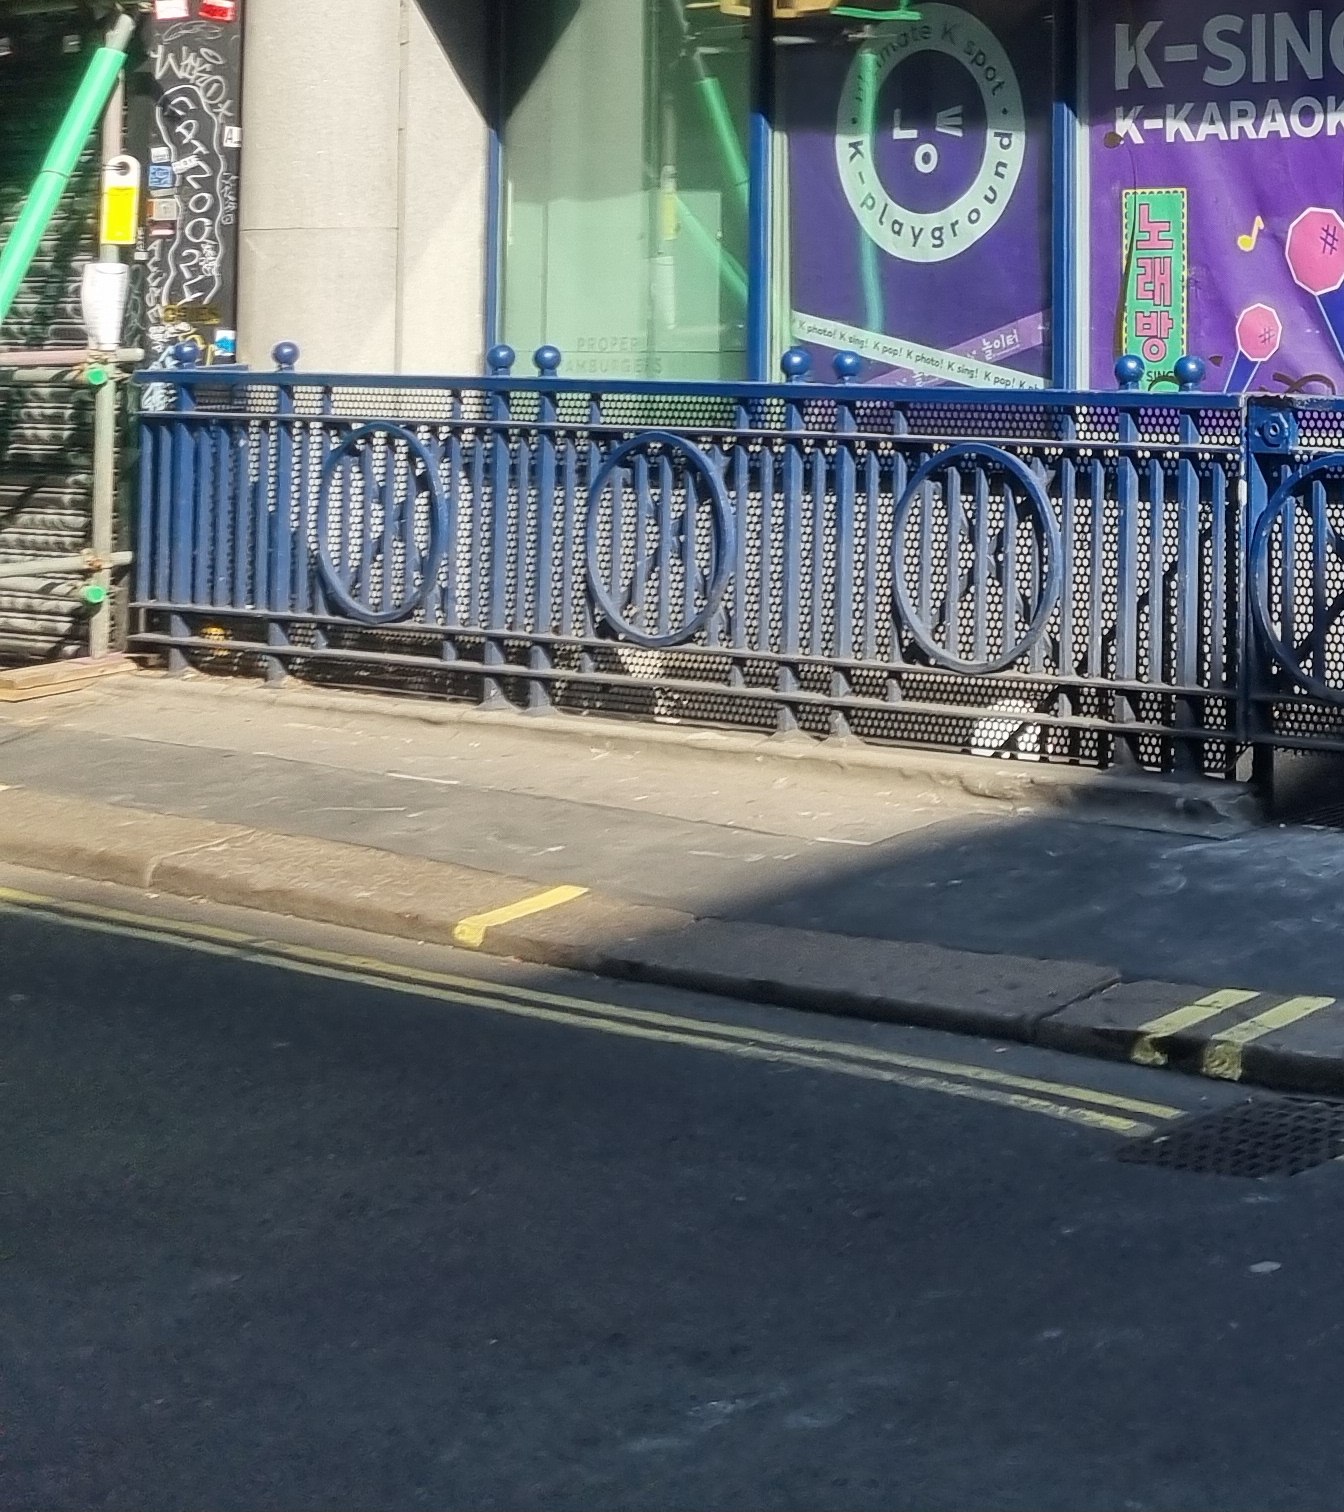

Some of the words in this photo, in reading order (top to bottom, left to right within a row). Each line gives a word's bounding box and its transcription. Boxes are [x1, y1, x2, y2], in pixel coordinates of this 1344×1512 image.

[963, 40, 1006, 96] spot
[847, 131, 1013, 249] K-playground
[1134, 202, 1174, 363] 노래방
[798, 320, 807, 331] K
[807, 323, 837, 339] photo!
[838, 331, 847, 341] K
[872, 341, 880, 352] K
[881, 345, 903, 358] pop!
[906, 349, 913, 360] K
[915, 353, 944, 369] photo!
[947, 360, 955, 371] K
[956, 364, 979, 378] sing!
[983, 371, 991, 382] K
[993, 376, 1016, 389] pop!
[981, 328, 1020, 361] 놀이터
